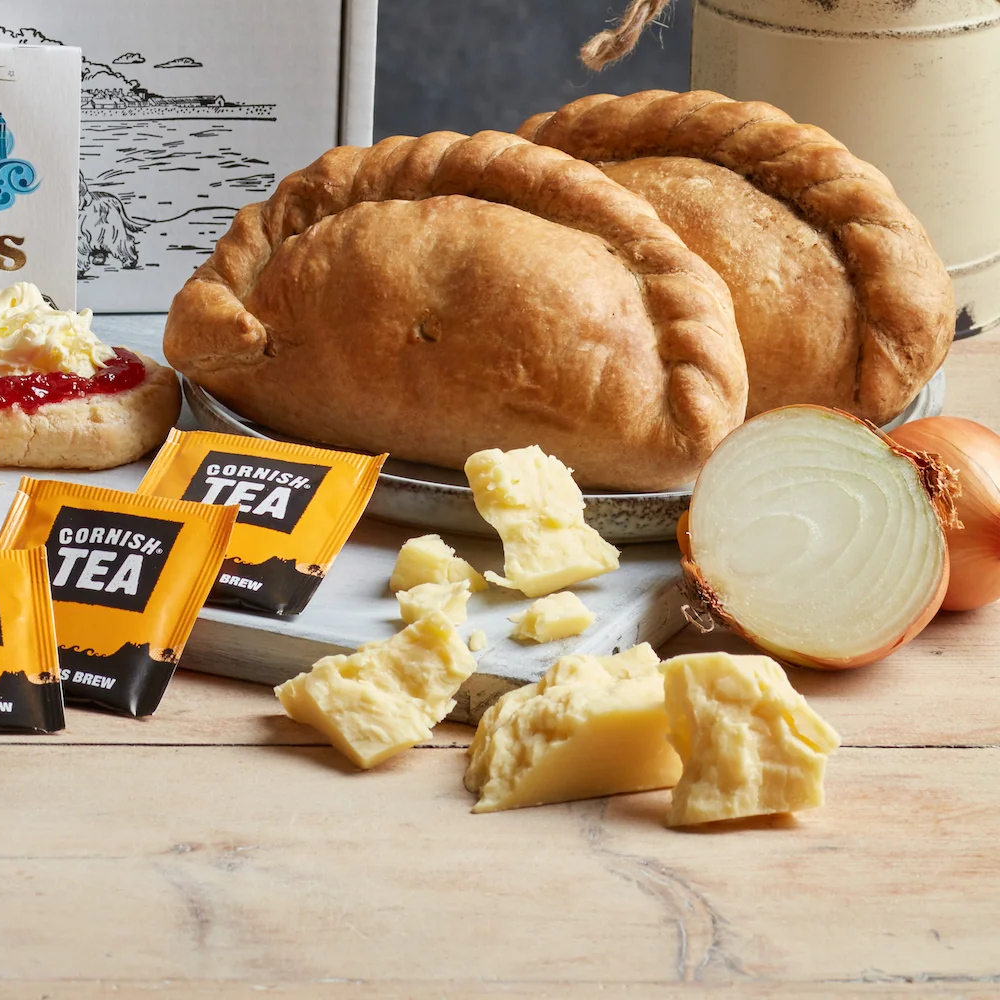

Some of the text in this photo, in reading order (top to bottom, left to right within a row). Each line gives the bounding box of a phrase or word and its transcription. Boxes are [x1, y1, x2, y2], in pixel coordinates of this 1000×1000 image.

[199, 477, 292, 520] TEA
[52, 547, 145, 596] TEA
[219, 573, 263, 592] BREW
[72, 672, 117, 690] BREW
